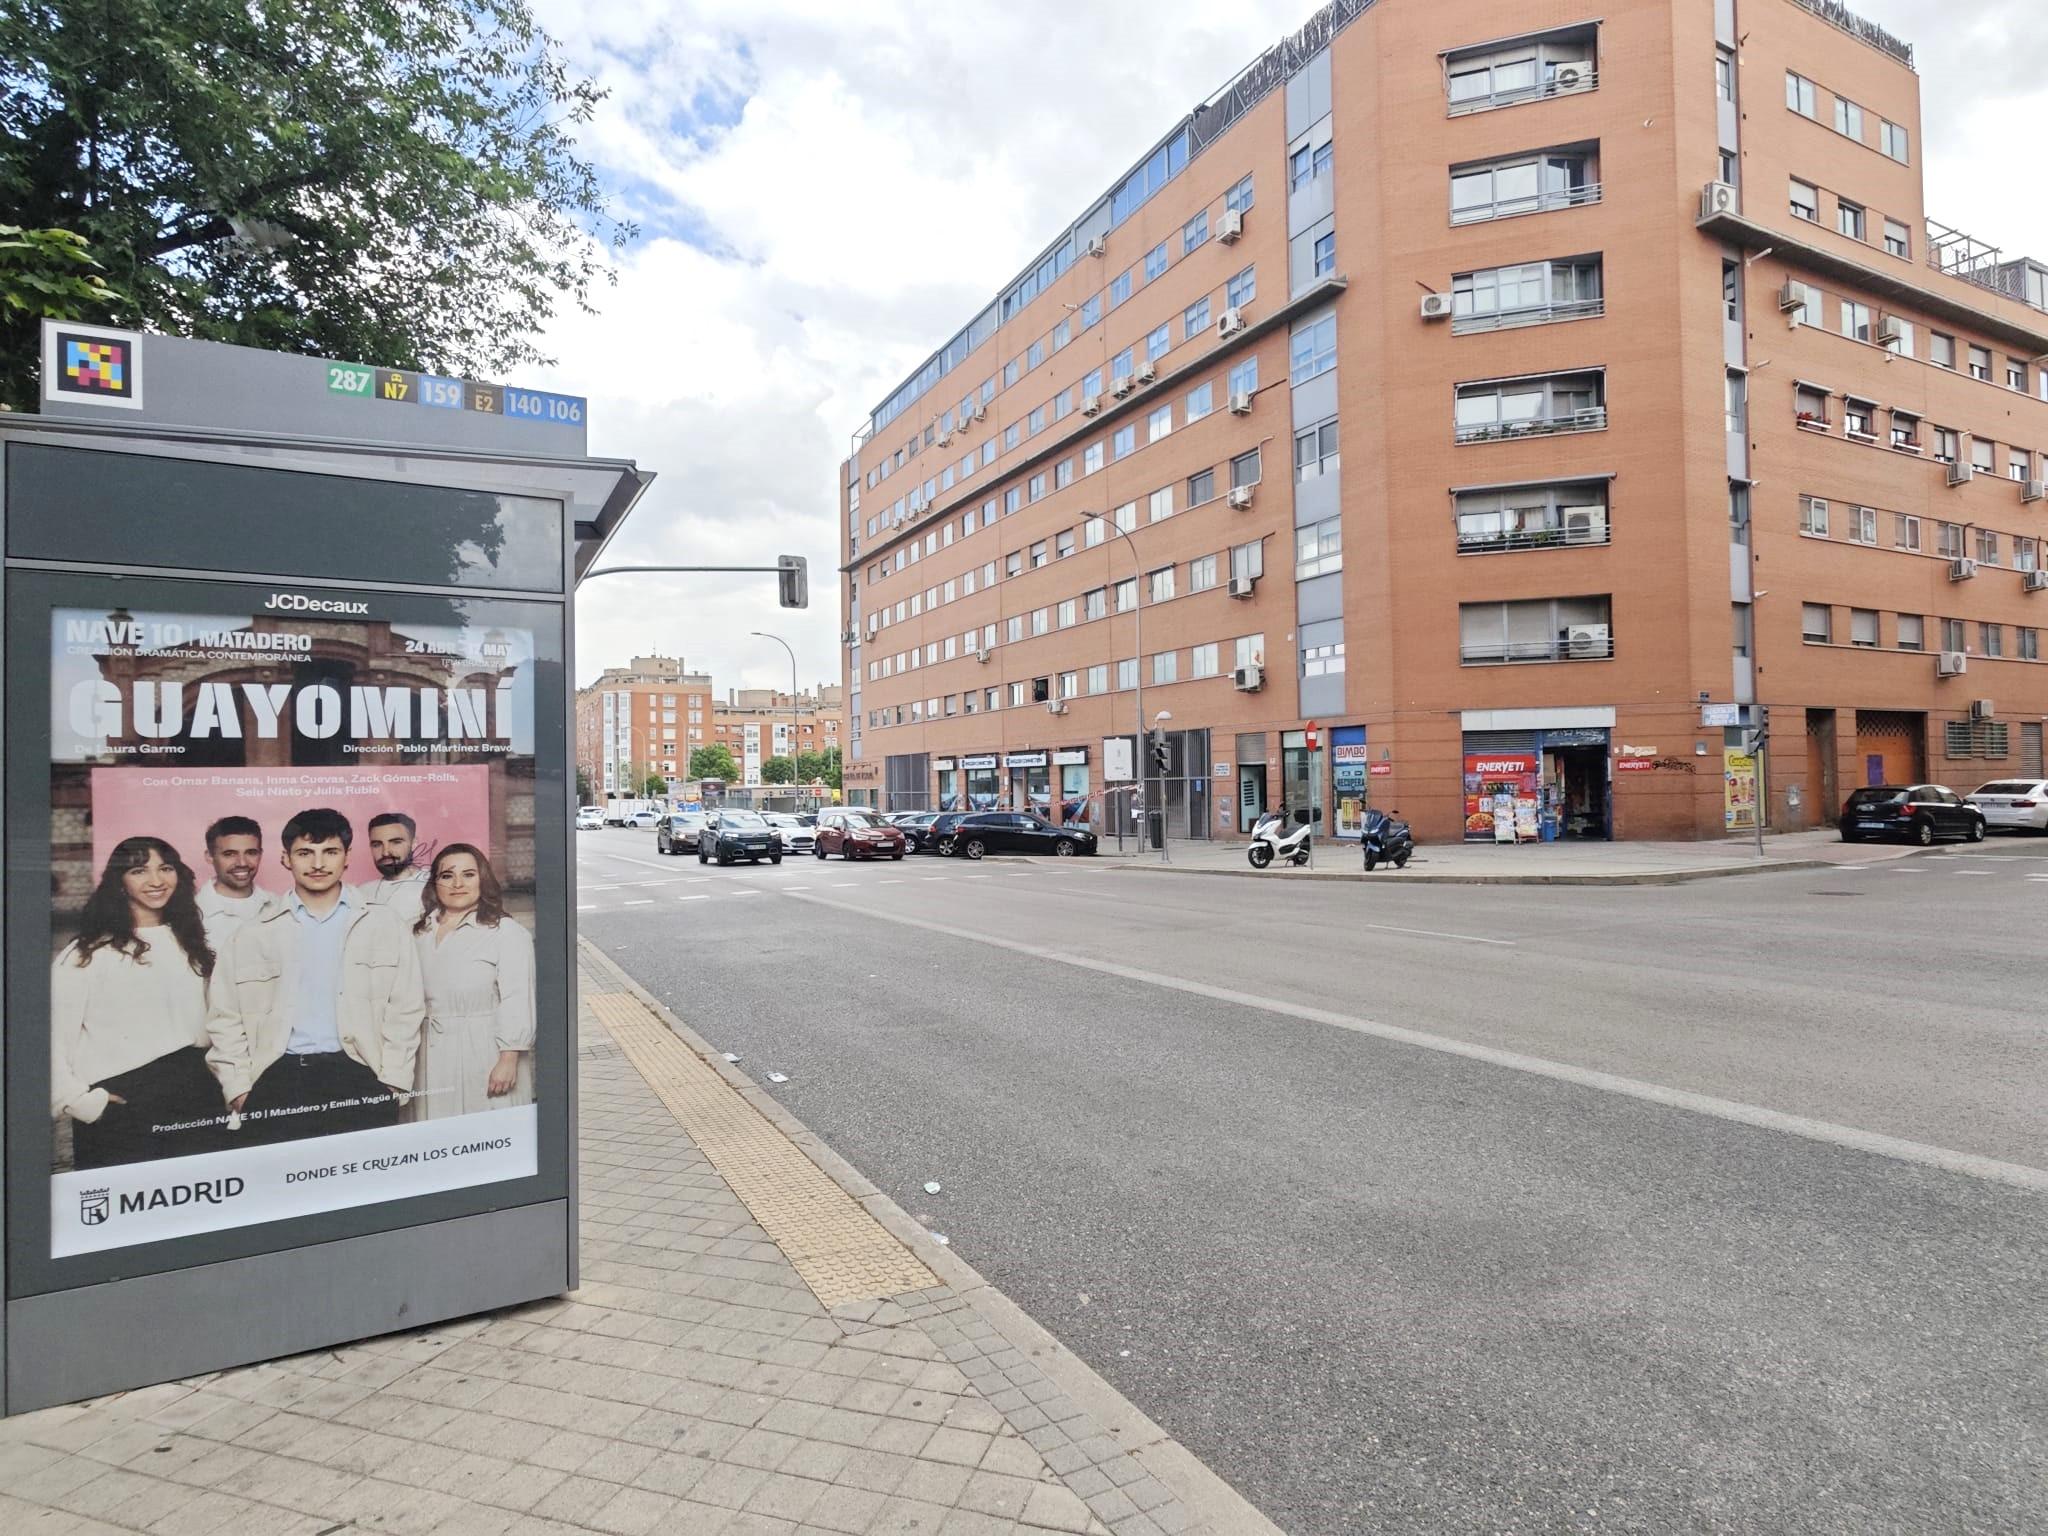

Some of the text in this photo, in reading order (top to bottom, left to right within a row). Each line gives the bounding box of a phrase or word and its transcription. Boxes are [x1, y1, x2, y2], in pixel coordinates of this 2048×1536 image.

[330, 368, 371, 393] 287
[384, 381, 409, 401] N7
[424, 381, 462, 406] 159
[475, 394, 494, 412] E2
[508, 392, 581, 422] 140 106
[264, 594, 368, 615] JCDecaux
[66, 619, 312, 651] NAVE 10 MATADERO
[134, 646, 205, 659] DRAMÁTICA
[206, 650, 312, 663] CONTEMPORÁNEA
[405, 640, 425, 653] 24
[483, 643, 512, 657] MAY
[69, 676, 515, 739] GUAYOMINÍ
[97, 744, 137, 754] Laura
[139, 744, 186, 754] Garmo
[343, 744, 513, 753] Dirección Pablo Martínez Bravo
[1337, 746, 1365, 758] BIMBO
[1476, 761, 1525, 773] ENERYETI
[143, 777, 168, 786] Con
[171, 776, 208, 786] Omar
[211, 776, 263, 787] Banana,
[266, 775, 297, 785] Inma
[351, 774, 381, 784] Zack
[267, 787, 302, 797] Nieto
[303, 788, 312, 797] y
[314, 785, 343, 796] Julia
[345, 785, 380, 795] Rubio
[152, 1118, 213, 1133] Producción
[249, 1110, 262, 1120] 10
[270, 1104, 320, 1118] Matadero
[321, 1103, 328, 1112] y
[330, 1098, 360, 1109] Emilia
[361, 1093, 391, 1105] Yagüe
[286, 1137, 512, 1183] DONDE SE CRUZAN LOS CAMINOS
[120, 1177, 245, 1215] MADRID
